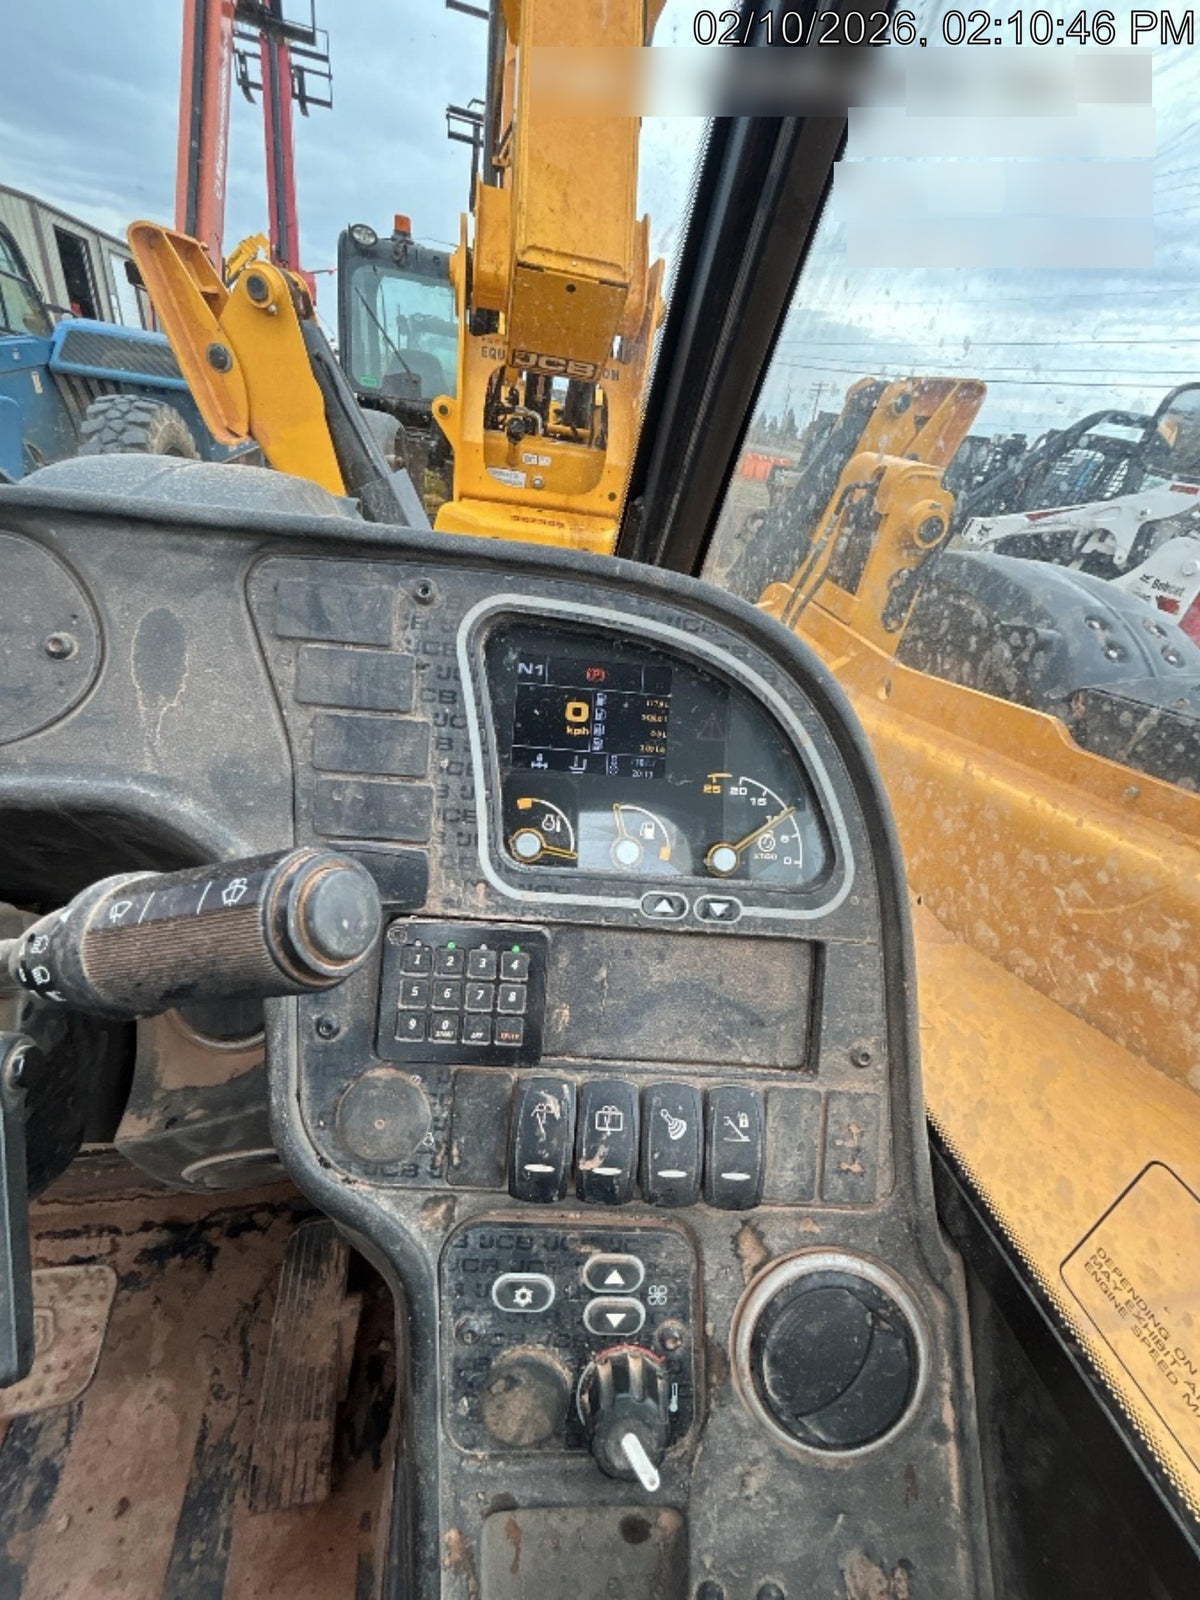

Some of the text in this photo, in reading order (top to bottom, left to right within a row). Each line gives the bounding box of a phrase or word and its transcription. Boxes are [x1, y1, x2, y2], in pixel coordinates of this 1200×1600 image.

[514, 350, 595, 379] JCB
[518, 662, 543, 676] N1
[565, 701, 589, 722] 0
[566, 725, 590, 737] kph
[703, 784, 721, 794] 25
[729, 787, 747, 796] 20
[750, 797, 767, 806] 15
[783, 857, 792, 865] 0
[414, 954, 519, 970] 1 2 3 4
[411, 986, 517, 1002] 5 6 7 8
[408, 1019, 449, 1030] 9 0
[1090, 1254, 1123, 1292] MAY
[1124, 1299, 1182, 1367] EXHIBIT
[1096, 1247, 1198, 1375] DEPENDING ON
[1084, 1260, 1200, 1417] ENGINE SPEED M
